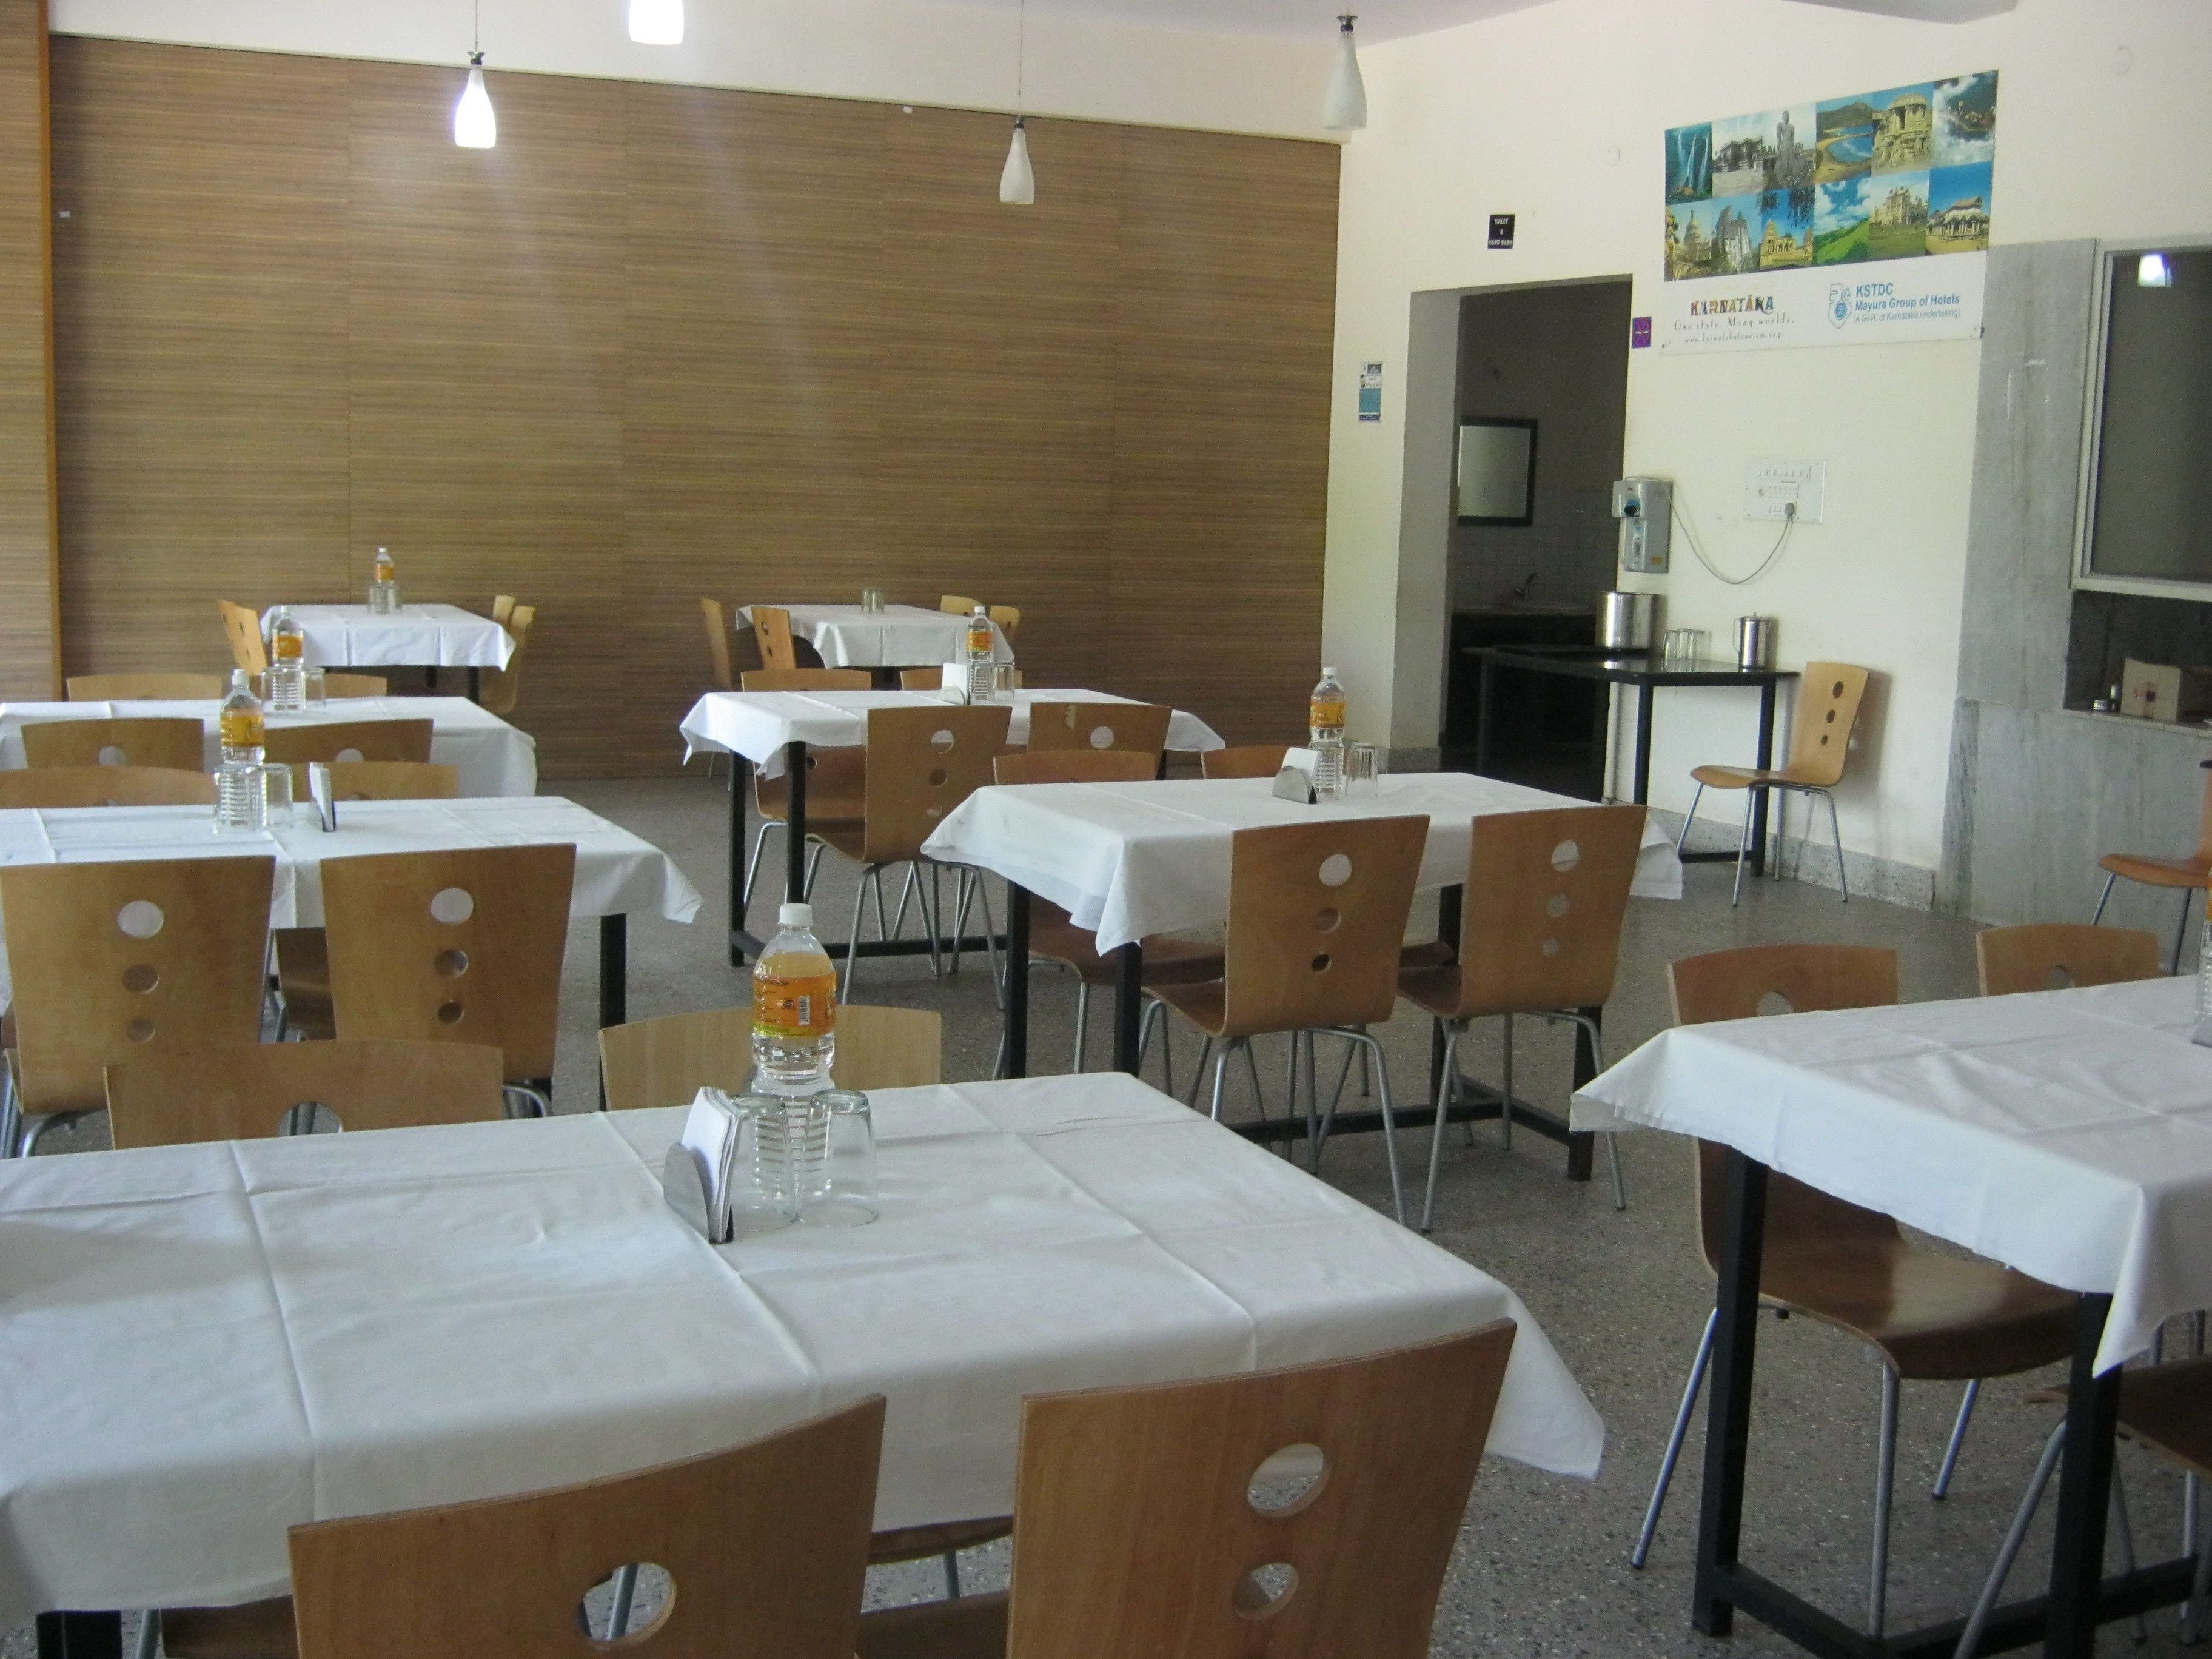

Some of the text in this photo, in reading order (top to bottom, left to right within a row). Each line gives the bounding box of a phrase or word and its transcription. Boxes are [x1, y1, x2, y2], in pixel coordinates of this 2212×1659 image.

[1856, 283, 1894, 298] KSTDC
[1690, 294, 1774, 316] KARNATAKA
[1855, 293, 1960, 312] Mayura Group of Hotels
[1674, 312, 1794, 331] One state. Many worlds.
[1886, 310, 1919, 321] Karnataka
[1920, 308, 1960, 318] undertaking)
